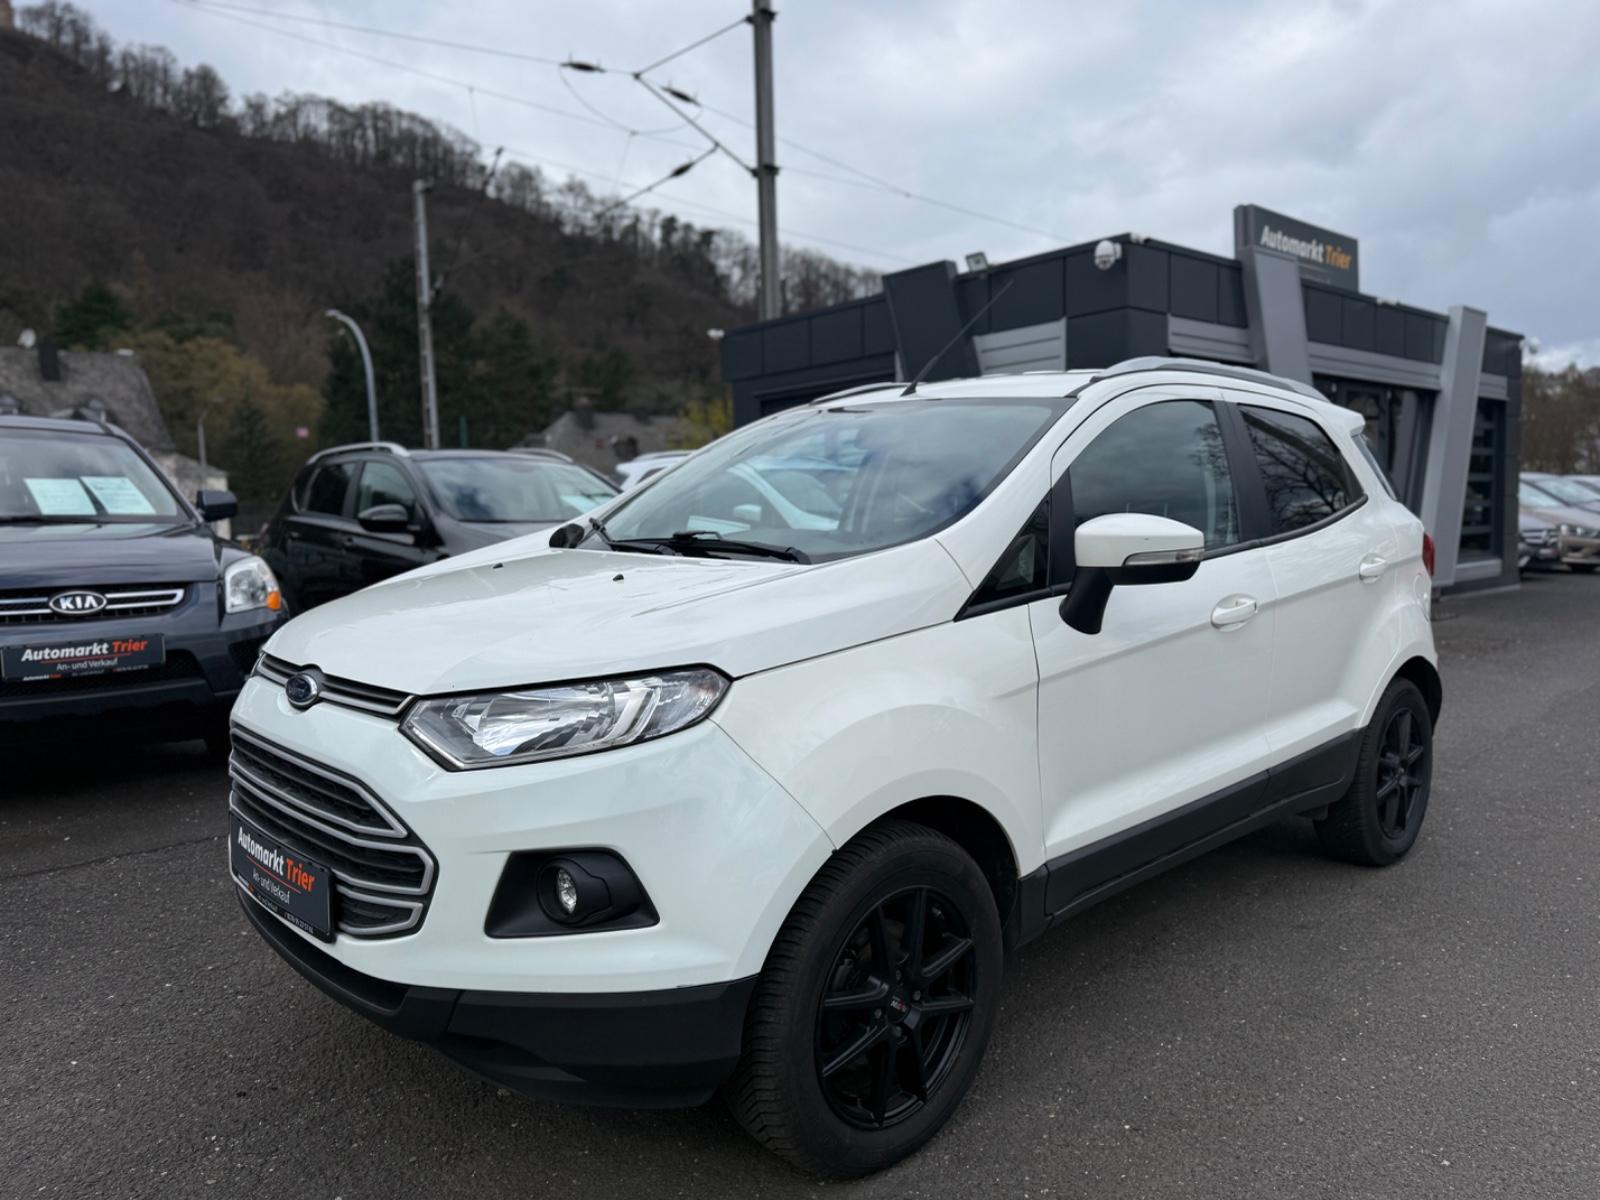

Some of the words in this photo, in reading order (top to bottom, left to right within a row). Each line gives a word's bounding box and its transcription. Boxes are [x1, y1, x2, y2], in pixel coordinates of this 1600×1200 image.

[1260, 224, 1324, 263] Automarkt
[1325, 243, 1351, 270] Trier
[60, 595, 99, 610] KIA
[21, 642, 109, 662] Automarkt
[111, 639, 148, 653] Trier
[56, 662, 71, 671] An-
[72, 661, 87, 670] und
[89, 657, 118, 668] Verkauf
[237, 826, 285, 876] Automarkt
[286, 858, 315, 892] Trier
